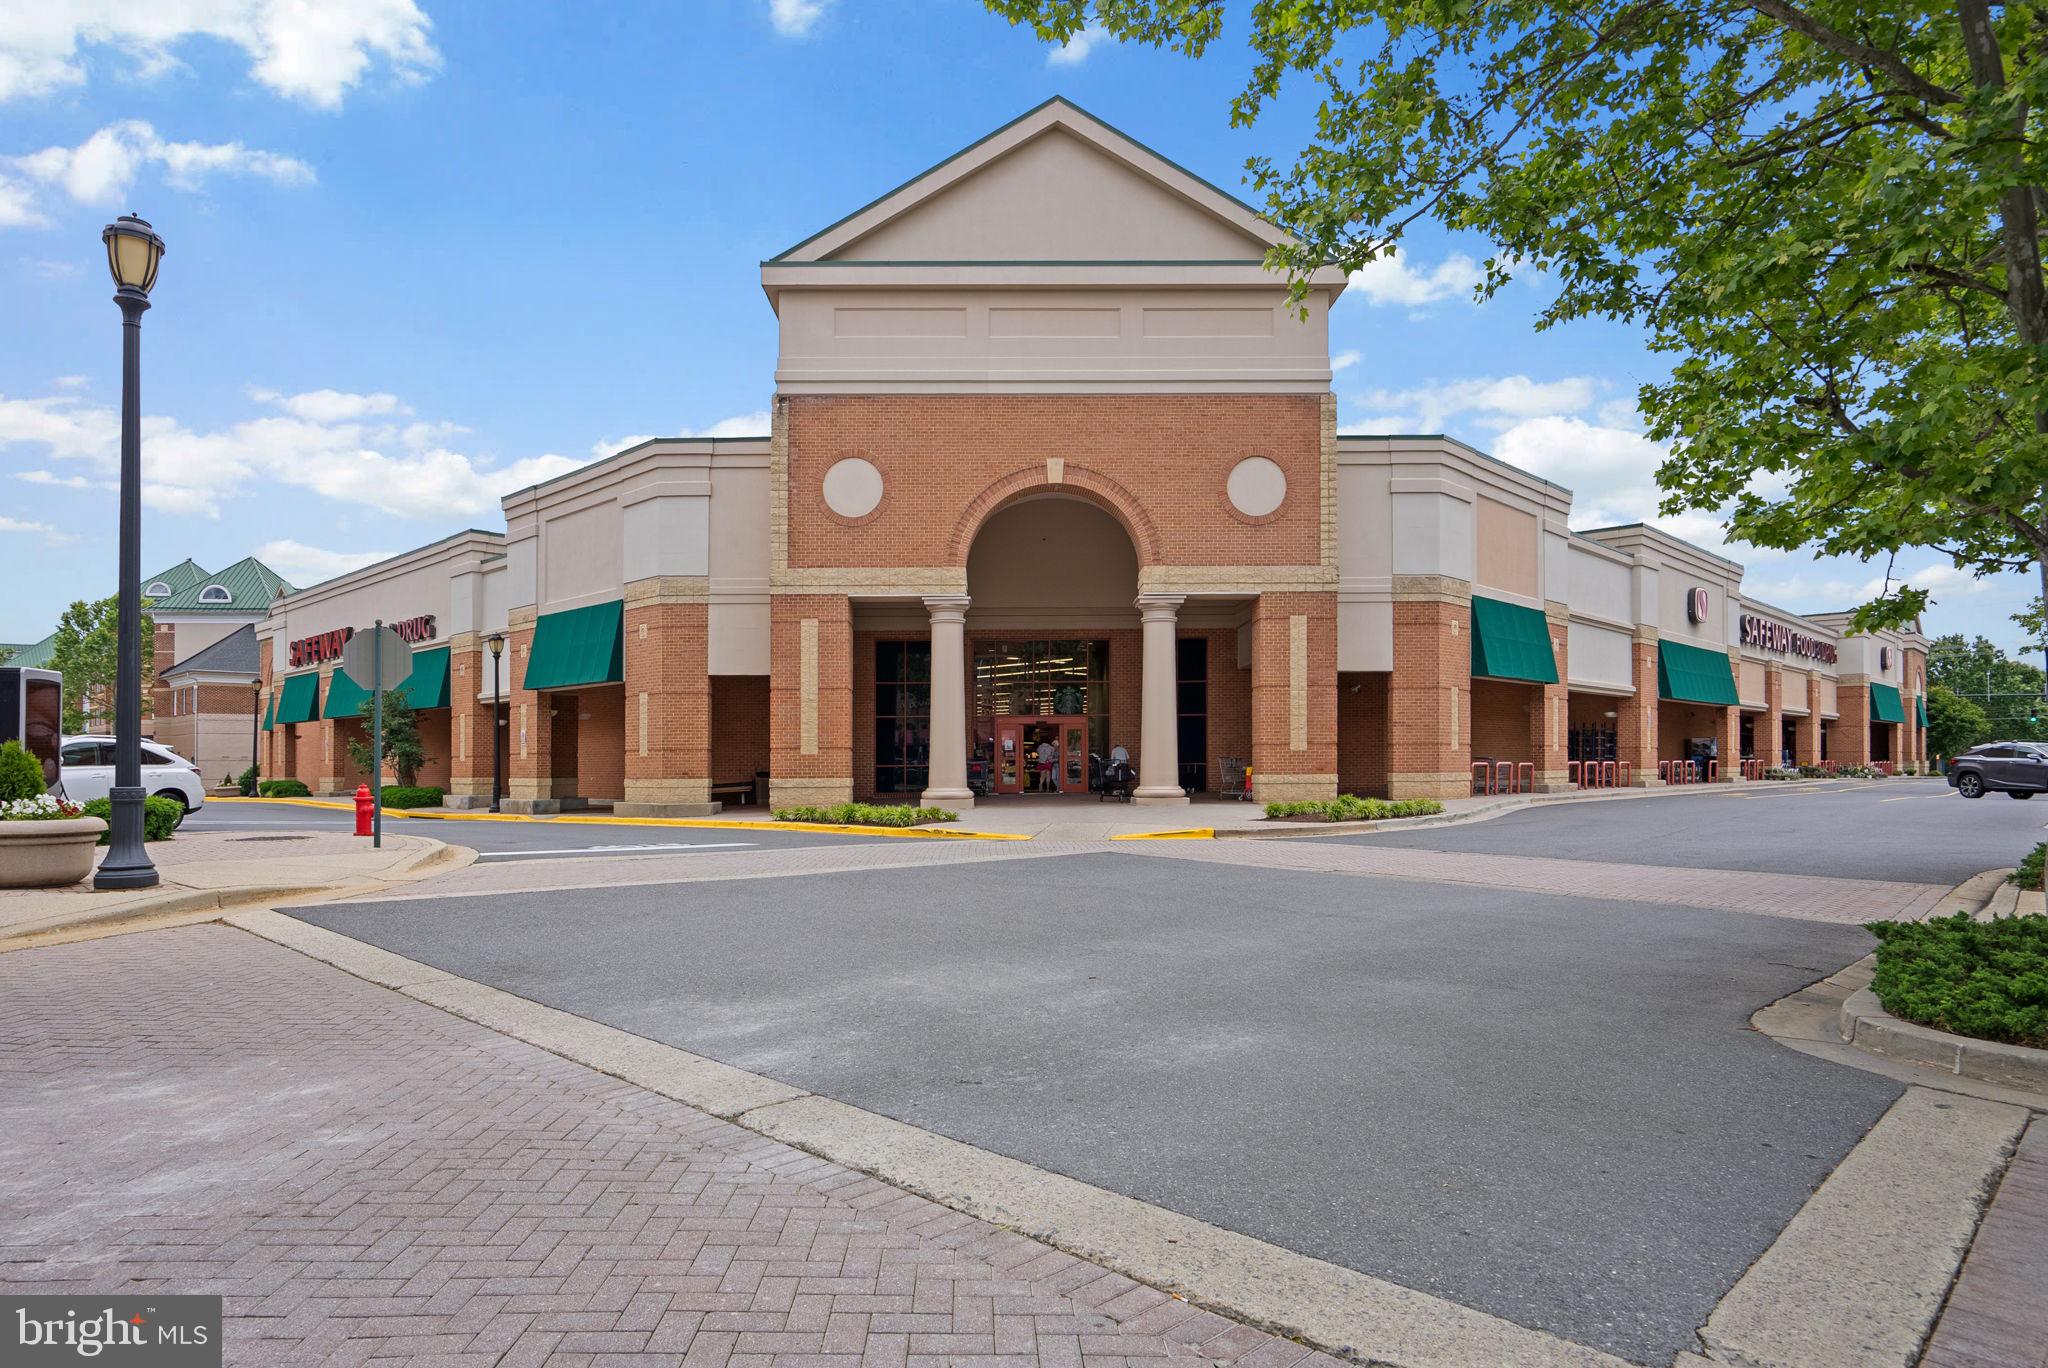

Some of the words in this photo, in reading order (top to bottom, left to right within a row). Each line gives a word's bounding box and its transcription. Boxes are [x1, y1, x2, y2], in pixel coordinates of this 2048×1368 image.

[289, 627, 353, 667] SAFEWAY
[397, 615, 436, 641] DRUG
[1743, 614, 1793, 653] SAFEWAY
[1796, 633, 1816, 658] FOOD
